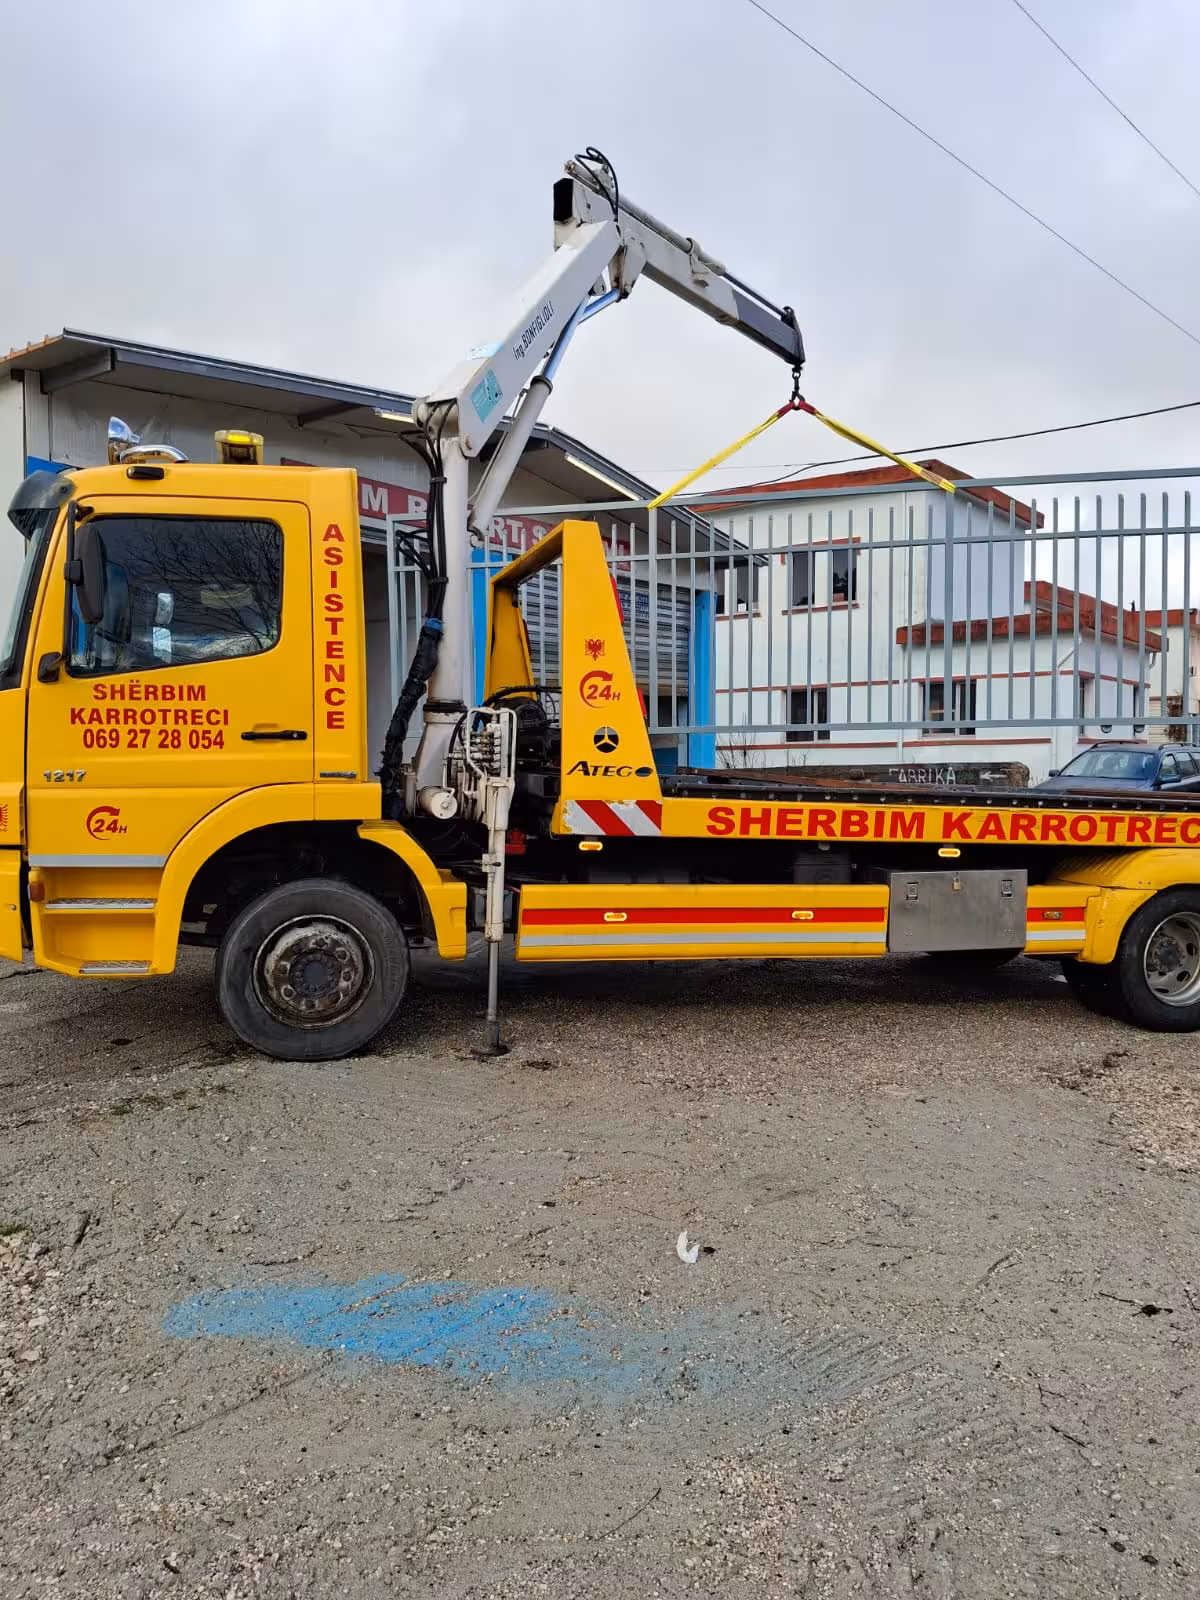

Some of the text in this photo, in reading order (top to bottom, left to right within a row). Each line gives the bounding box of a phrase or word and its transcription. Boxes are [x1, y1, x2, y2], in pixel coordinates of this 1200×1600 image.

[322, 523, 346, 730] ASISTENCE
[93, 679, 206, 702] SHËRBIM
[586, 684, 621, 701] 24H
[70, 708, 229, 726] KARROTRECI
[83, 728, 224, 750] 069 27 28 054
[43, 769, 87, 783] 1217
[93, 818, 128, 834] 24H
[706, 805, 1200, 844] SHERBIM KARROTREC
